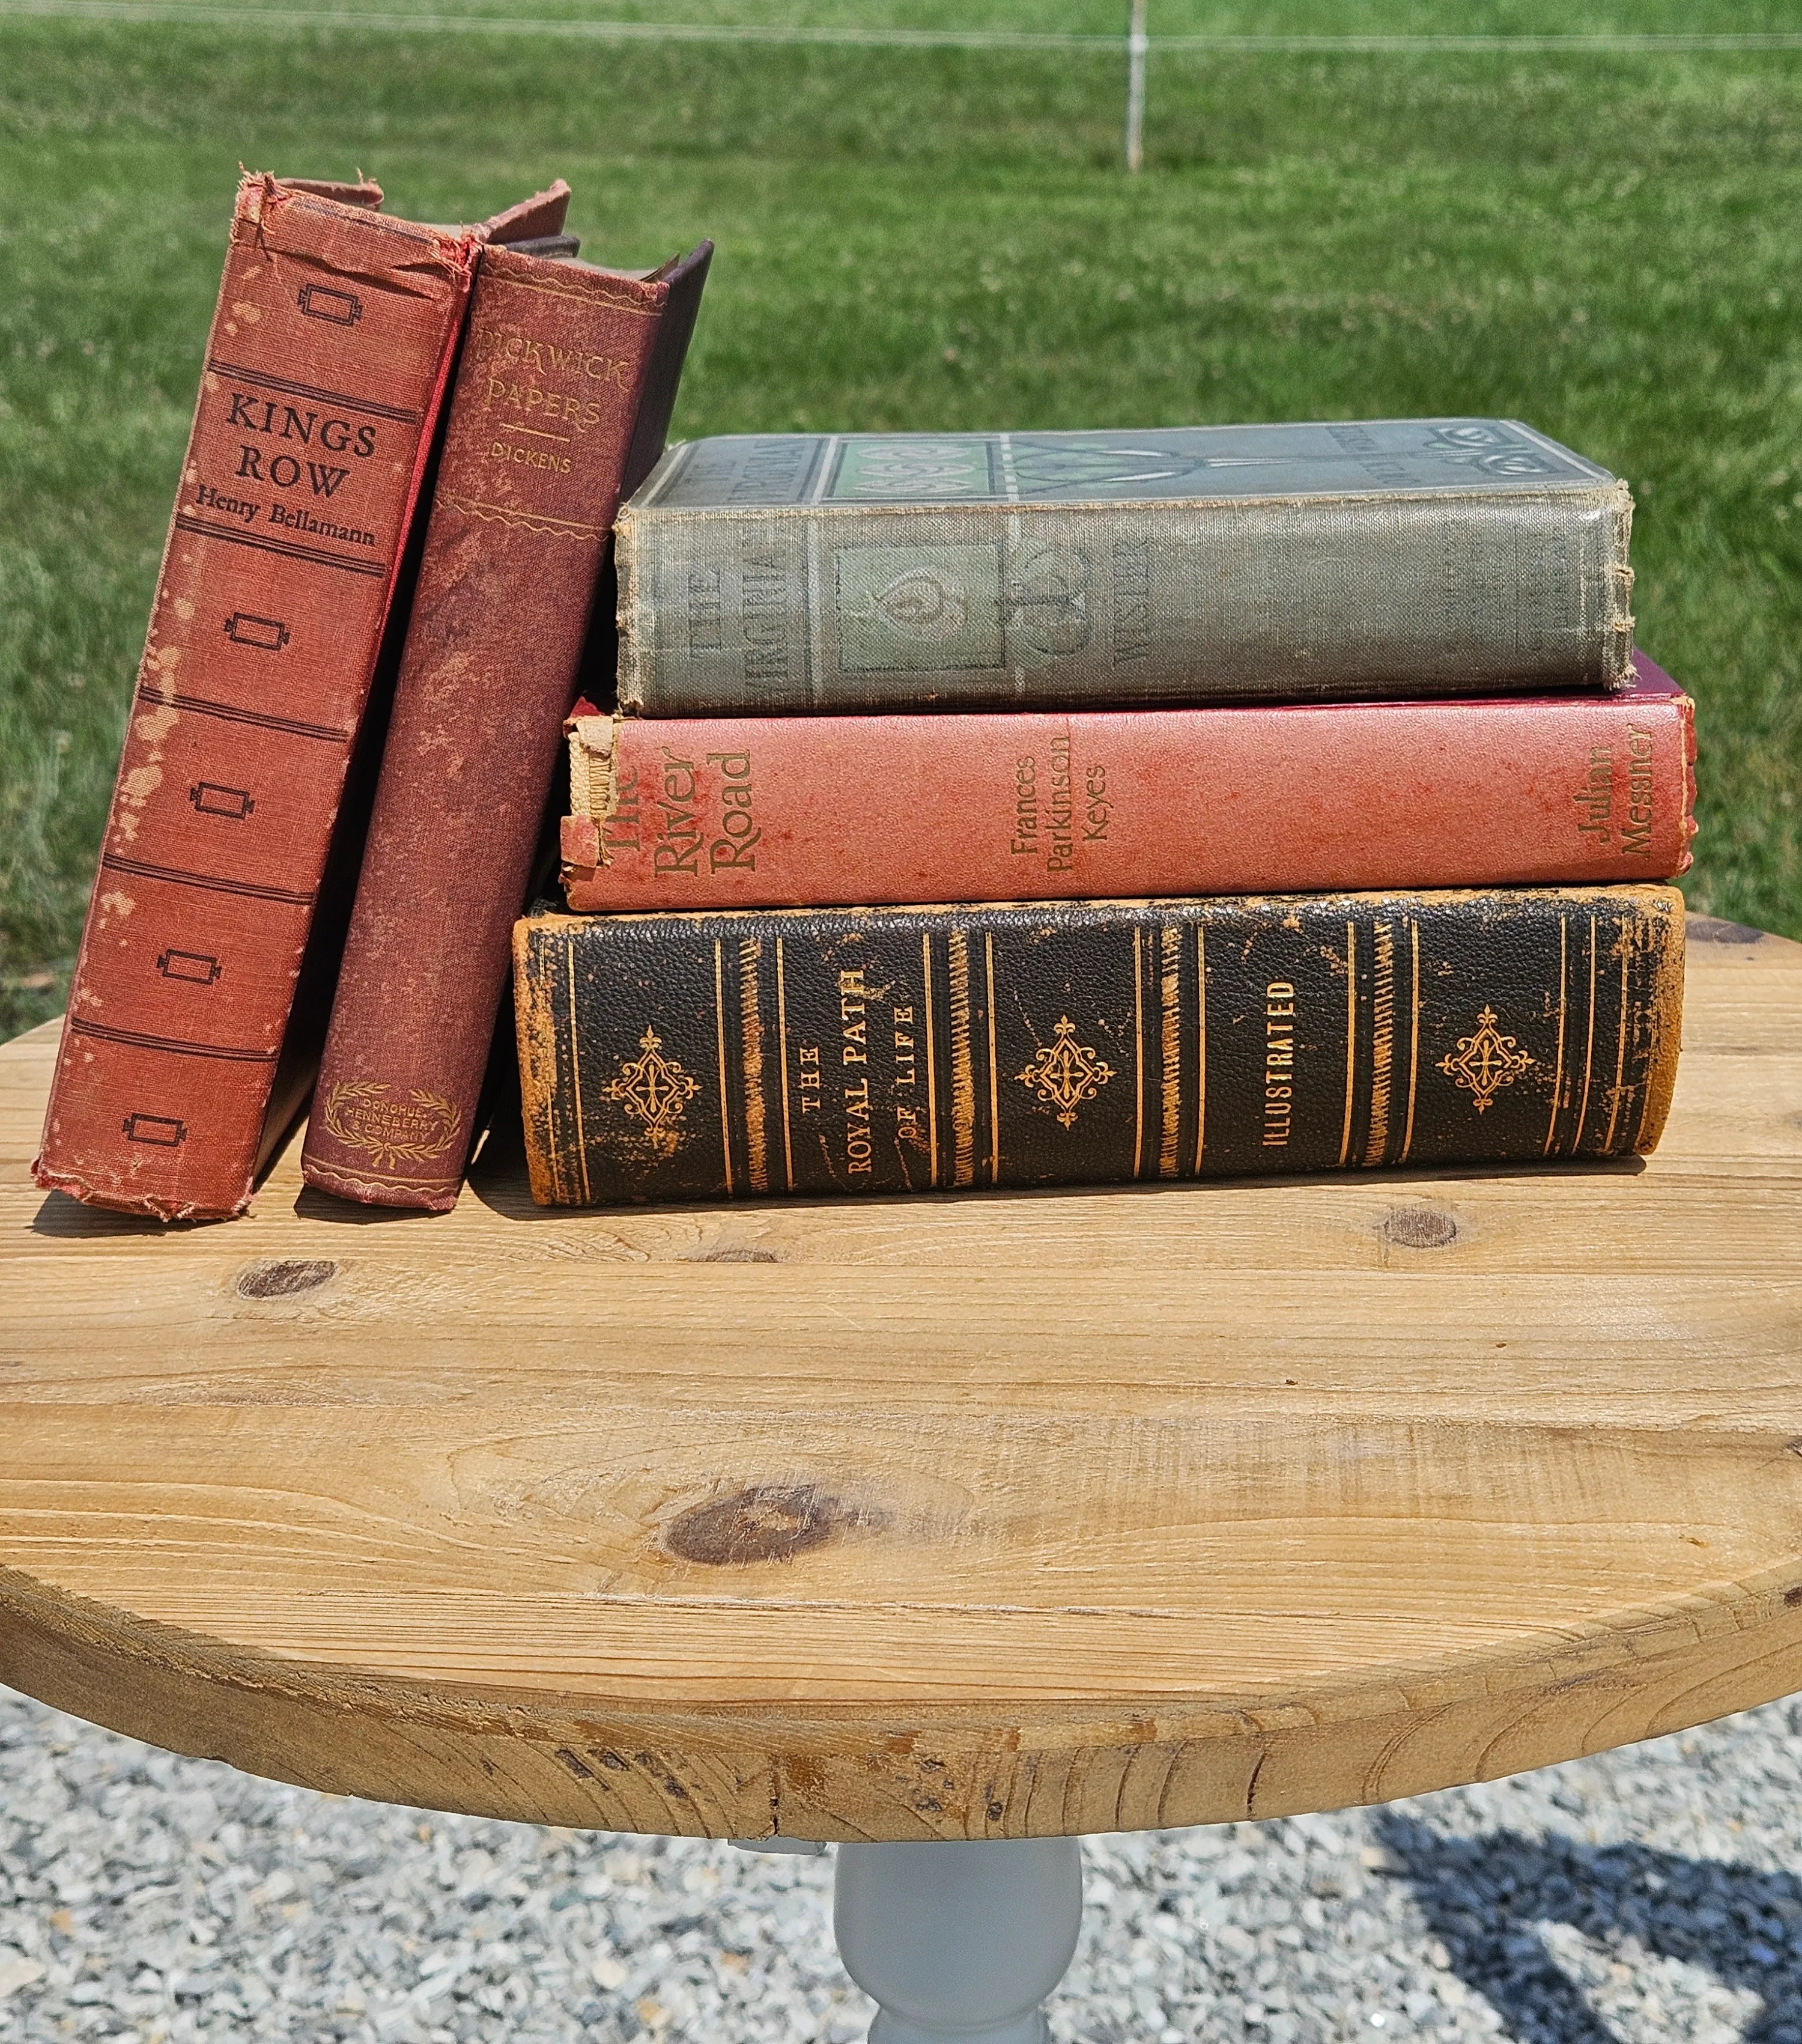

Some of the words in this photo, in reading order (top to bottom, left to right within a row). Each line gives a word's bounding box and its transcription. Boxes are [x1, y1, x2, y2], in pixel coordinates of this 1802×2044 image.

[478, 329, 630, 392] PICKWICK
[226, 392, 377, 459] KINGS
[482, 377, 601, 433] PAPERS
[235, 444, 351, 499] ROW
[491, 441, 571, 474] DICKENS
[195, 485, 261, 523] Henry
[268, 503, 377, 547] Bellamann
[654, 745, 705, 878] River
[706, 749, 762, 875] Road
[1010, 755, 1038, 855] Frances
[1045, 736, 1073, 872] Parkinson
[1081, 765, 1114, 842] Keyes
[1572, 745, 1613, 847] Julian
[1621, 723, 1653, 859] Messner
[840, 969, 867, 1066] PATH
[894, 1005, 916, 1086] LIFE
[799, 1046, 821, 1115] THE
[1261, 981, 1295, 1146] ILLUSTRATED
[345, 1107, 439, 1131] HENNEBERRY
[364, 1123, 431, 1143] COMPANY
[845, 1077, 873, 1175] ROYAL
[897, 1106, 918, 1140] OF
